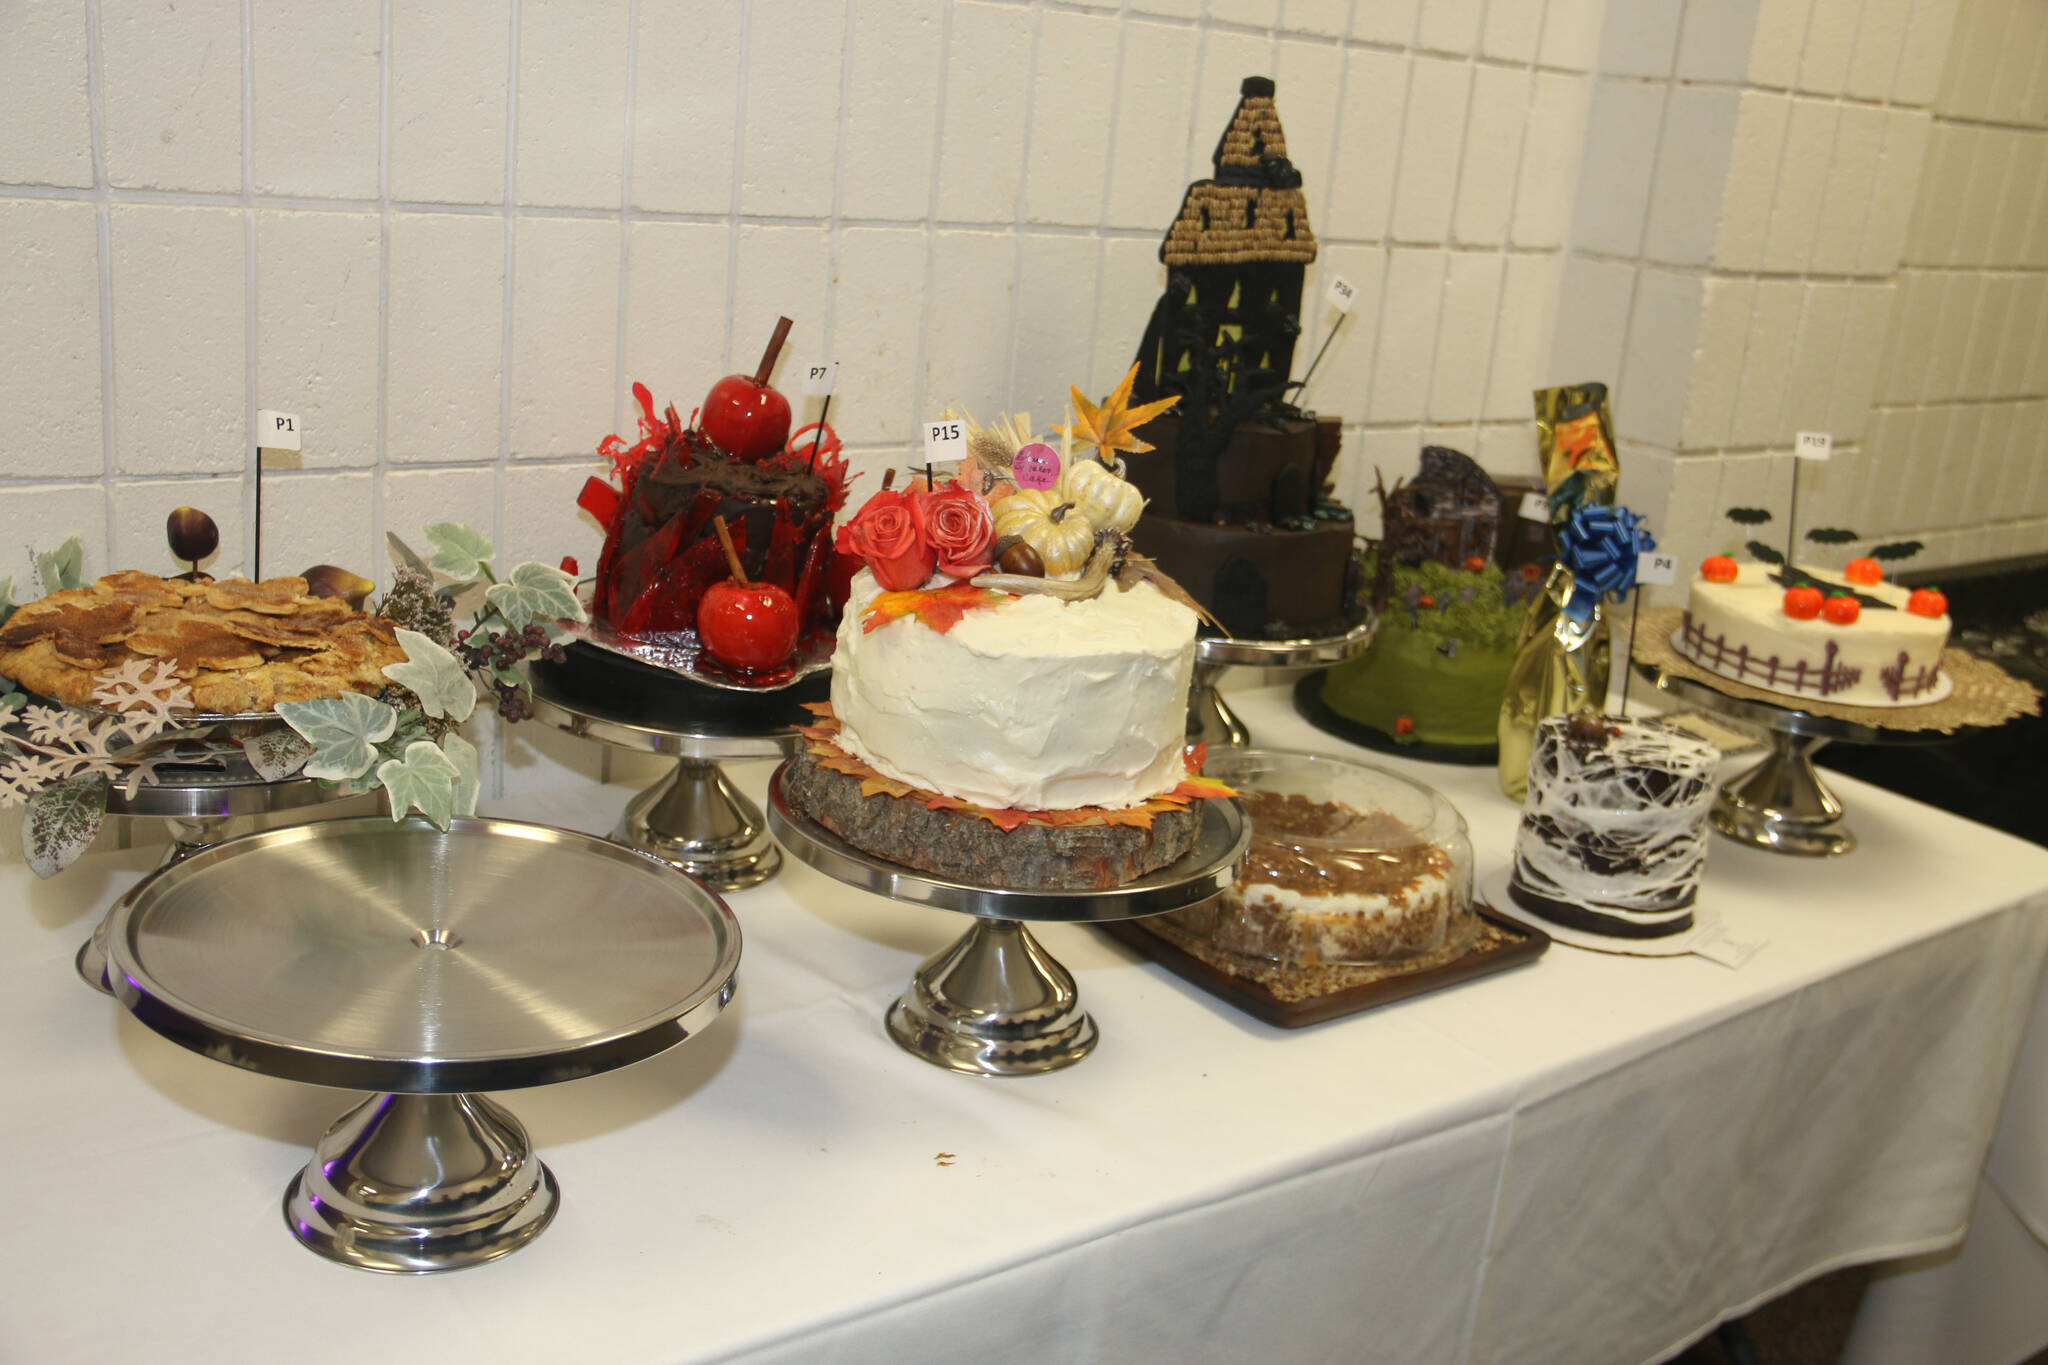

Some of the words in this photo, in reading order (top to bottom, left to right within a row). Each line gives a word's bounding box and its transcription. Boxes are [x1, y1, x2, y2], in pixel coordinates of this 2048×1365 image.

[810, 367, 827, 380] P7
[276, 417, 294, 431] P1
[932, 424, 960, 441] P15
